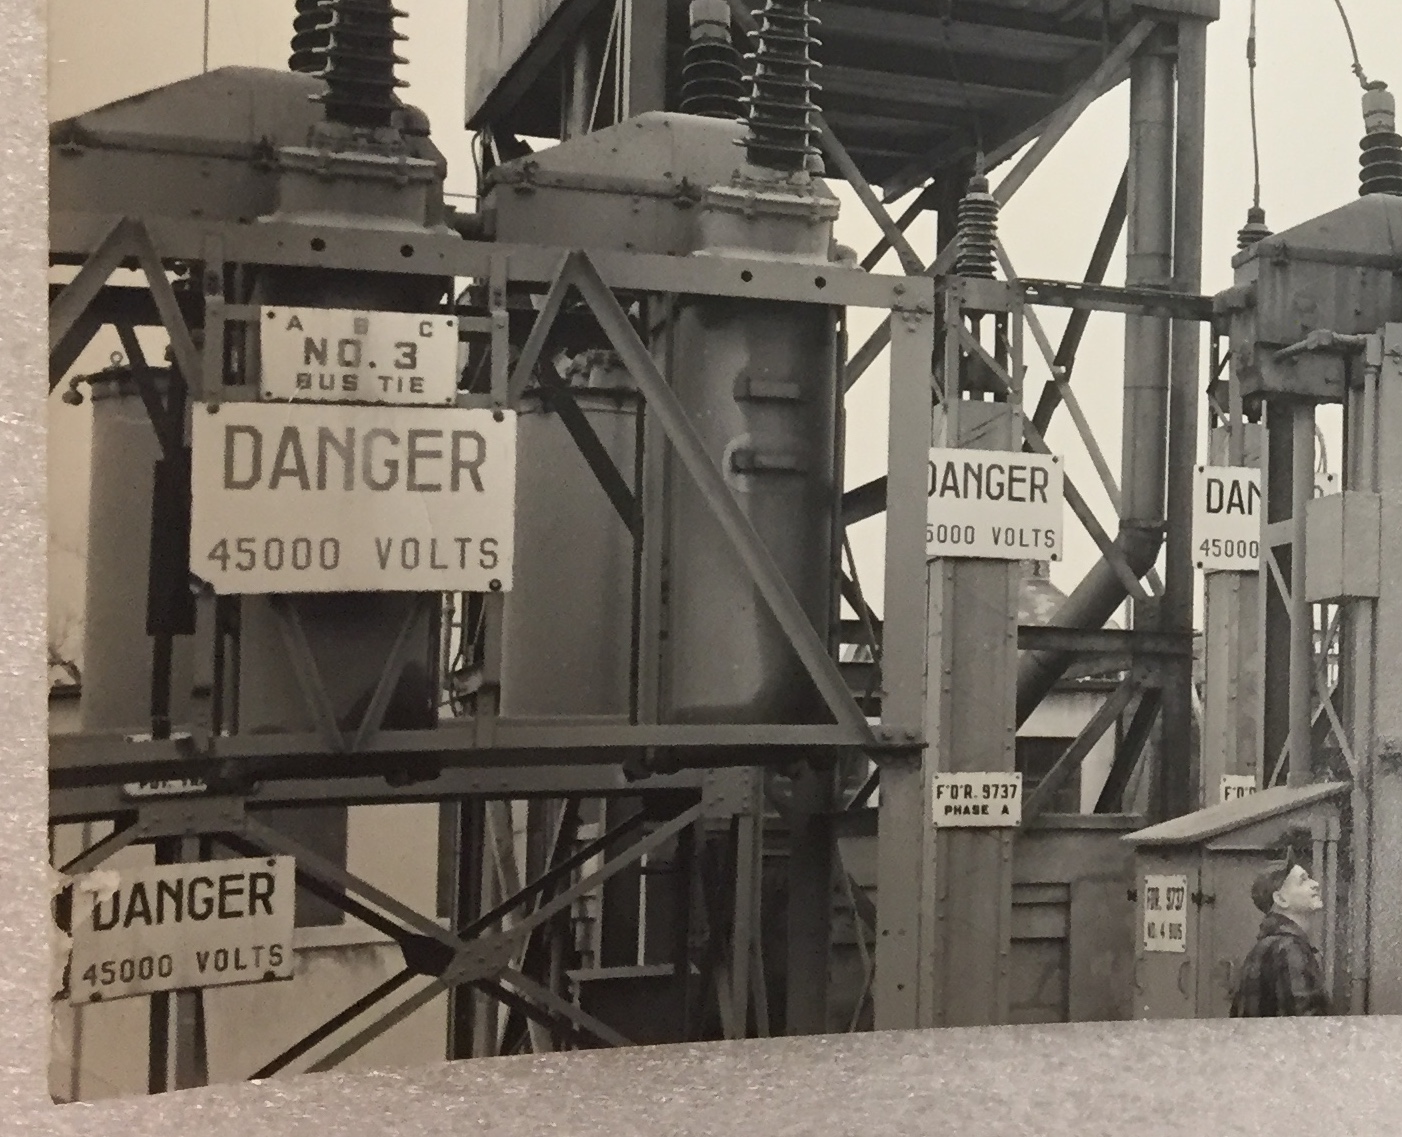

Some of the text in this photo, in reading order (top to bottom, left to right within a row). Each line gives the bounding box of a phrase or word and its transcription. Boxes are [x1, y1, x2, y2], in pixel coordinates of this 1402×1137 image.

[286, 315, 304, 332] A
[419, 320, 433, 337] C
[393, 341, 418, 370] 3
[296, 372, 425, 394] BUS TIE
[223, 424, 487, 492] DANGER
[992, 526, 1056, 548] VOLTS
[1199, 538, 1259, 558] 45000
[207, 537, 500, 571] 45000 VOLTS
[982, 784, 1018, 800] 9737
[944, 804, 1010, 816] PHASE A
[92, 872, 275, 931] DANGER
[82, 944, 283, 987] 45000 VOLTS
